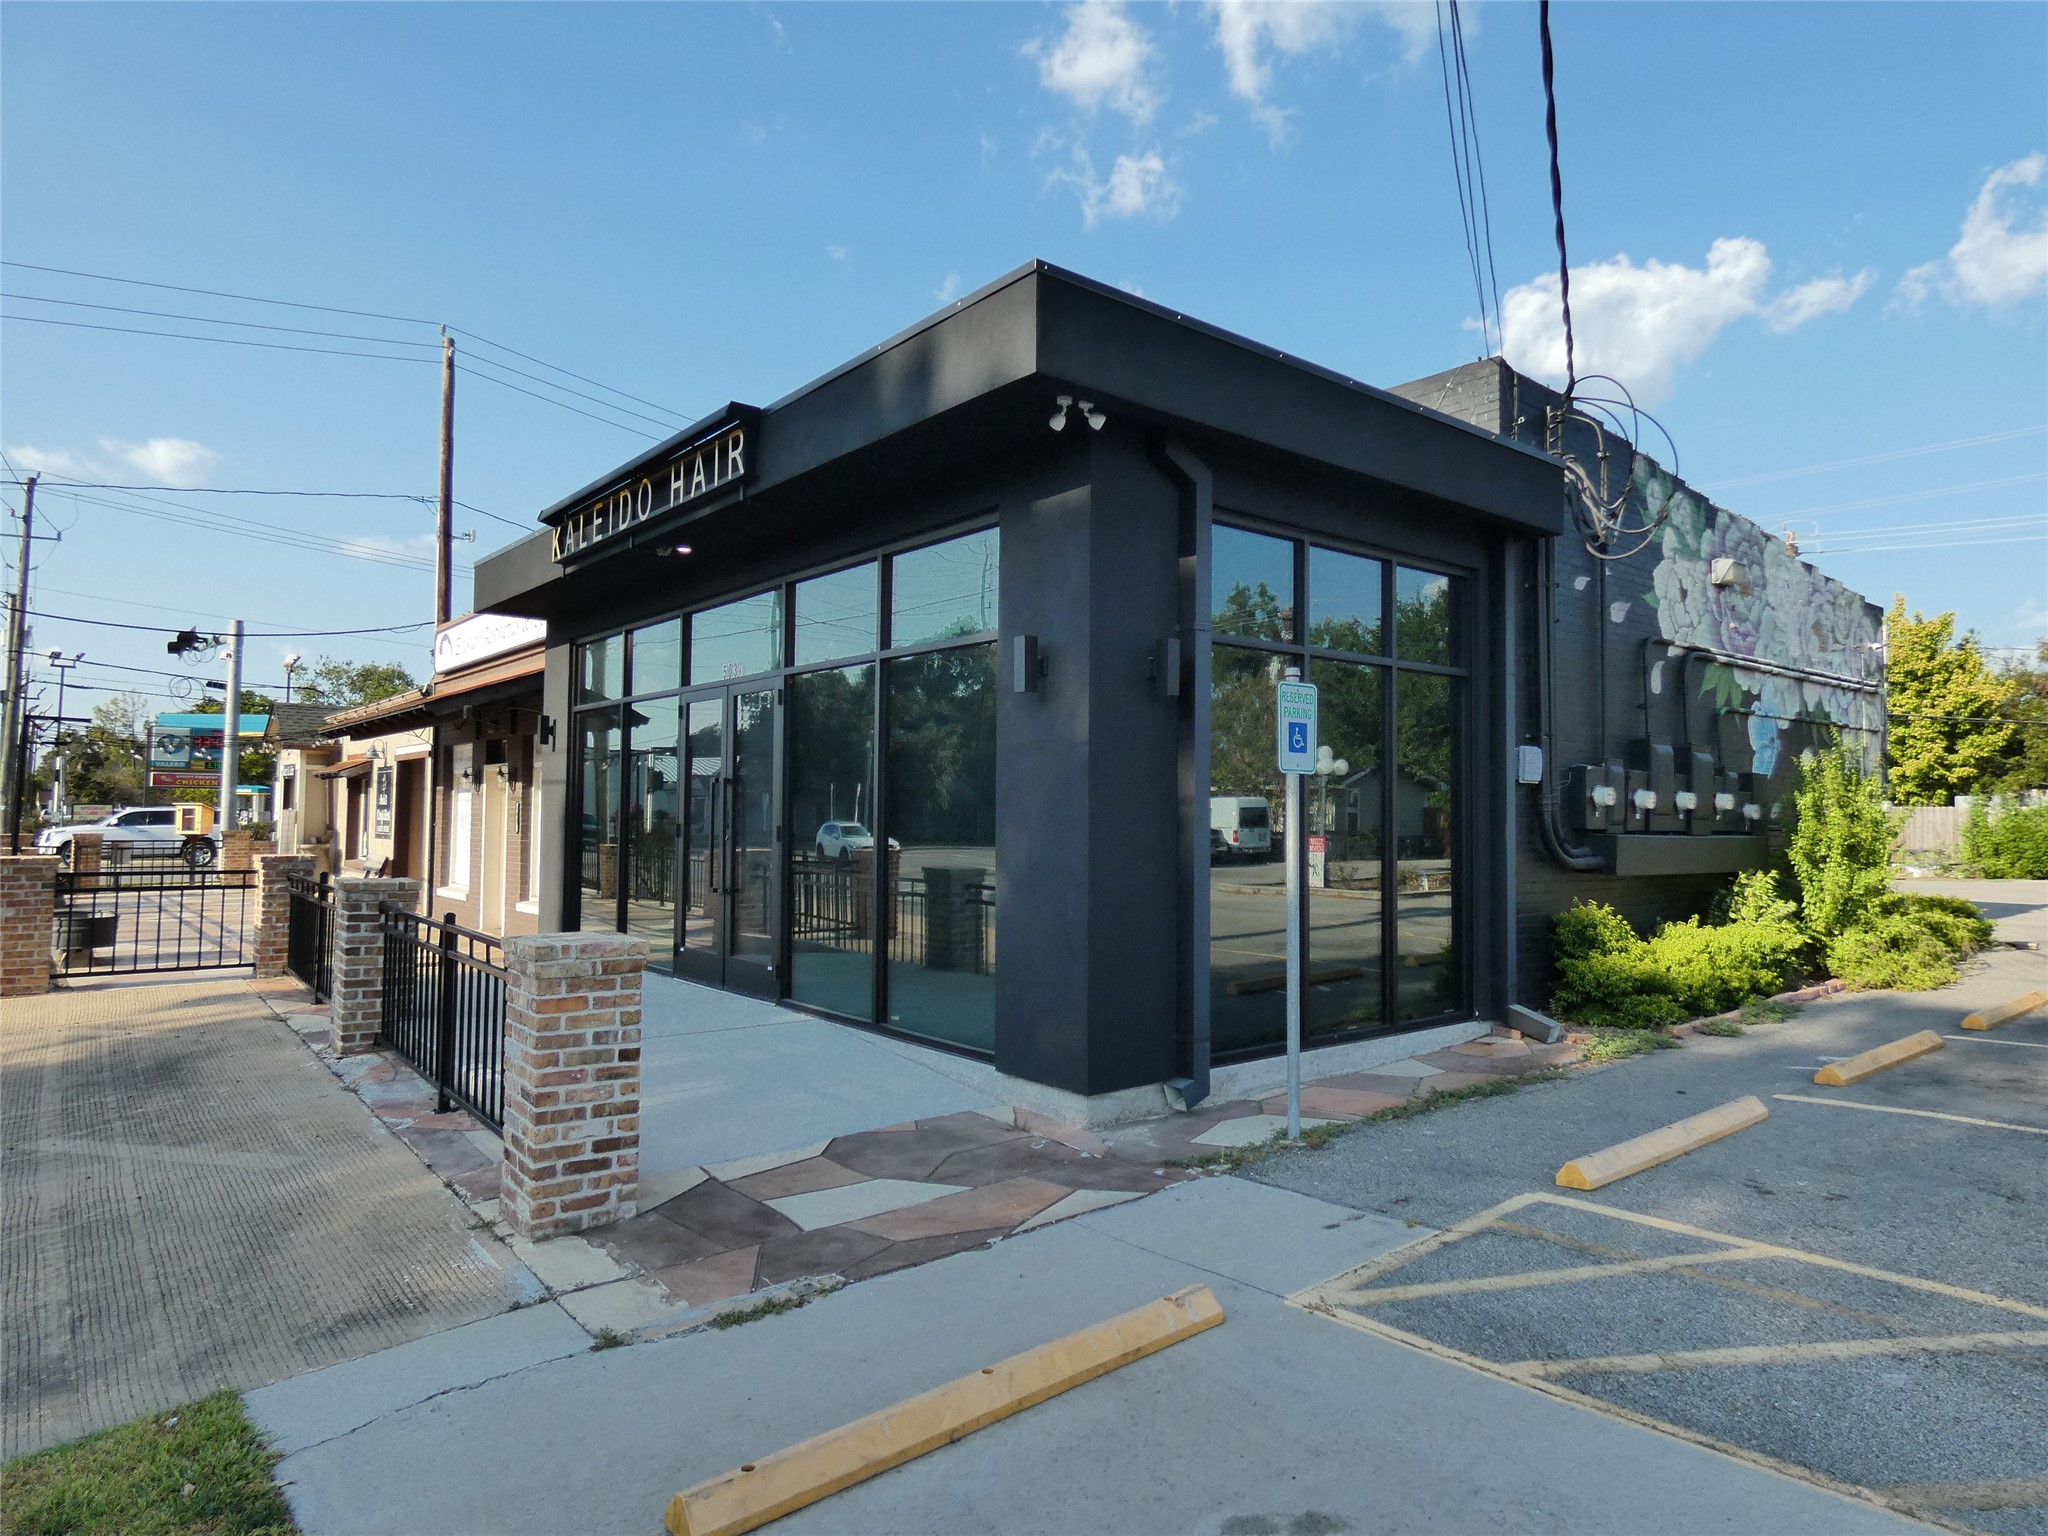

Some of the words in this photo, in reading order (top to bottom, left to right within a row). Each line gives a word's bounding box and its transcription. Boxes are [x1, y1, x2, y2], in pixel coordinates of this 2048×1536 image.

[551, 477, 652, 563] KALEIDO
[670, 428, 745, 508] HAIR
[1281, 691, 1314, 705] RESERVED
[1283, 706, 1312, 720] PARKING
[175, 779, 218, 787] CHICKEN
